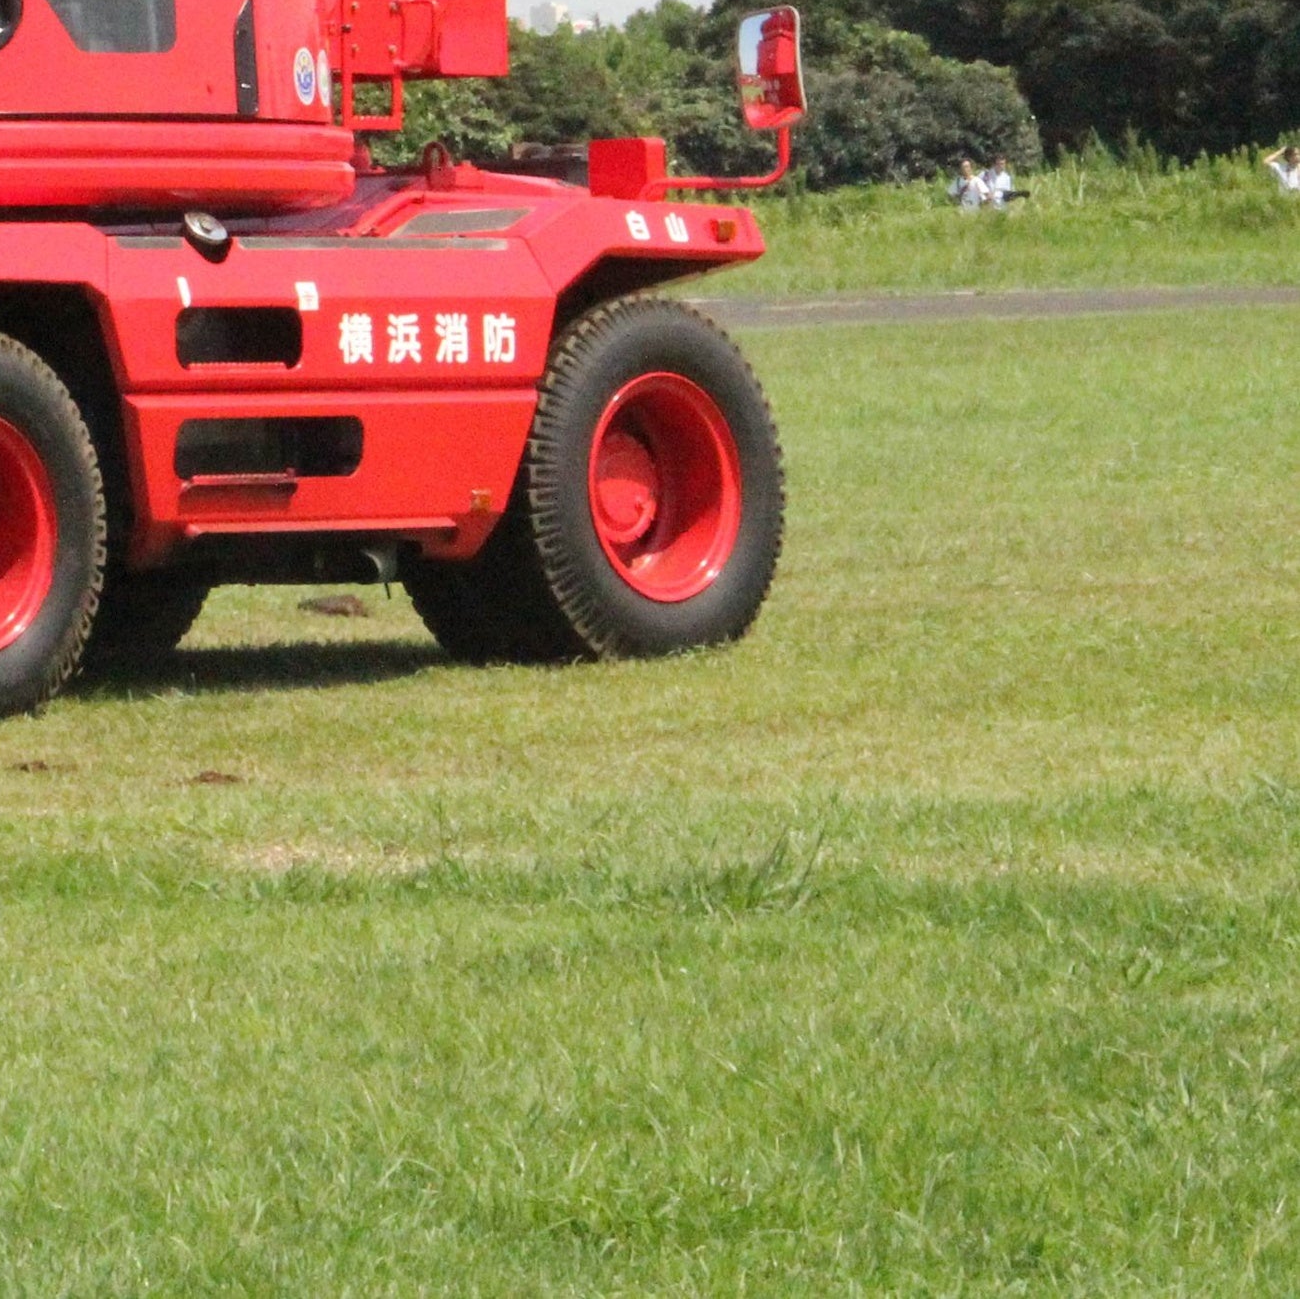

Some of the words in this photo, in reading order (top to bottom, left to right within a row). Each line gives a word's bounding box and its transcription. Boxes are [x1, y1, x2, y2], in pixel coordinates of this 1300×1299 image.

[625, 209, 690, 243] 白山
[338, 311, 517, 364] 横浜消防
